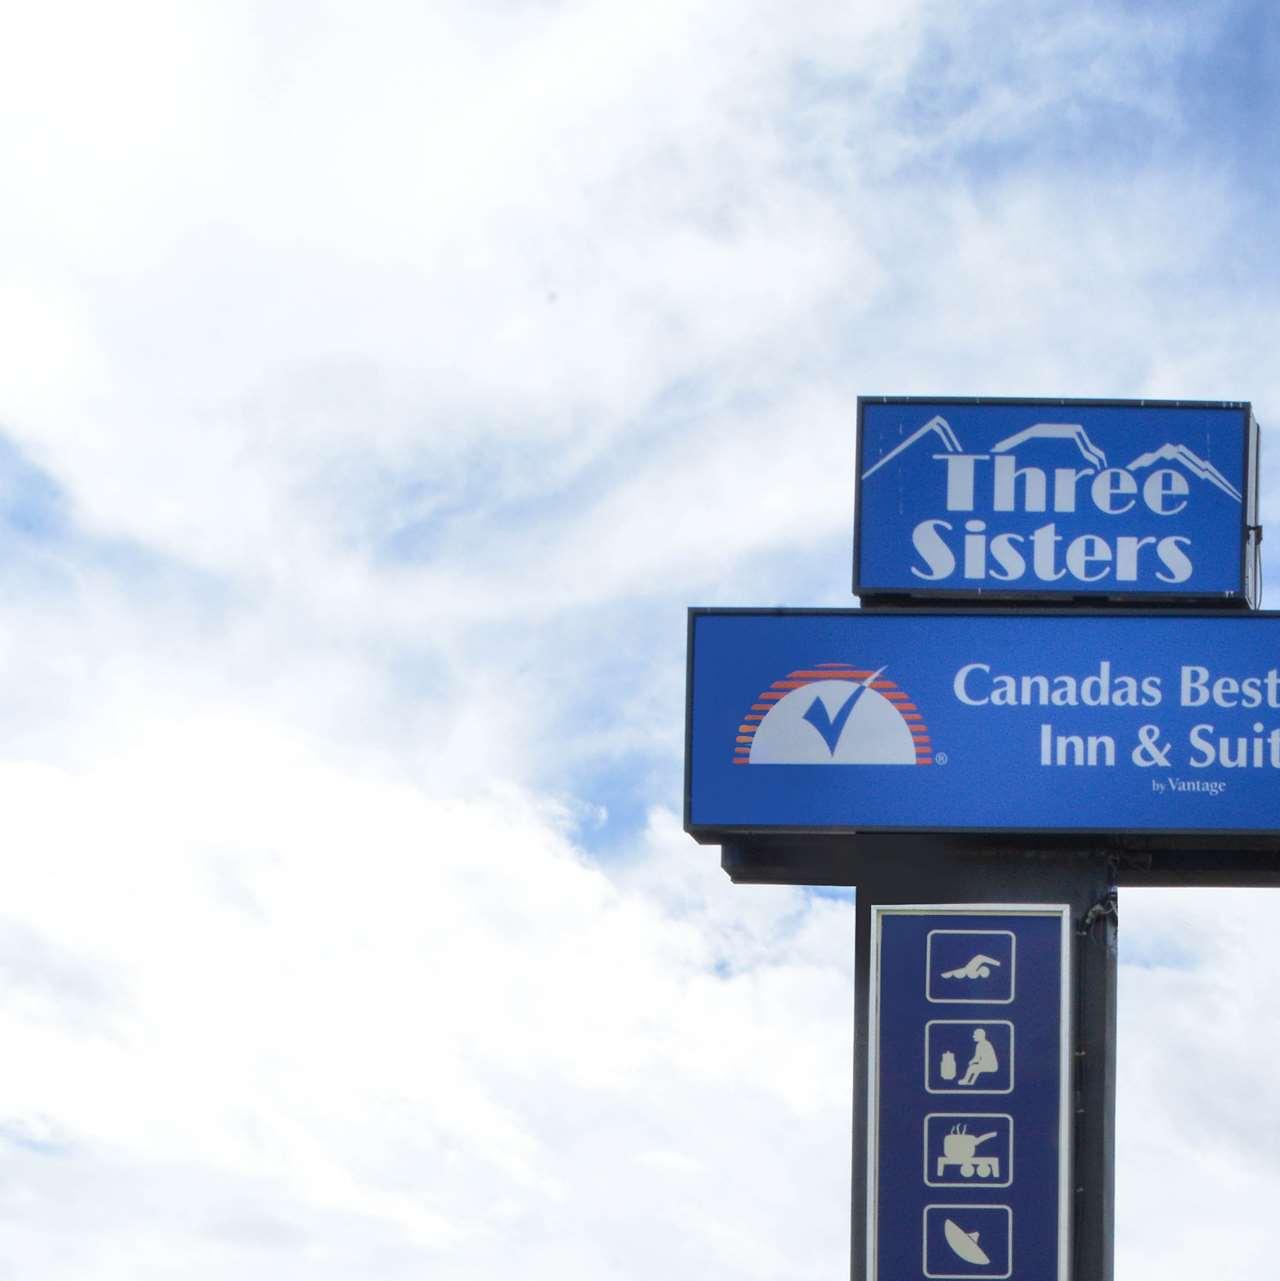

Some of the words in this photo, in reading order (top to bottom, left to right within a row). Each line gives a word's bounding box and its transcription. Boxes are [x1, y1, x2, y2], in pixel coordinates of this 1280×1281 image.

[931, 453, 1189, 516] Three
[911, 519, 1193, 583] Sisters
[953, 661, 1162, 706] Canadas
[1180, 665, 1280, 708] Best
[1040, 724, 1115, 766] Inn
[1131, 724, 1172, 767] &
[1151, 778, 1166, 795] by
[1167, 776, 1227, 797] Vantage
